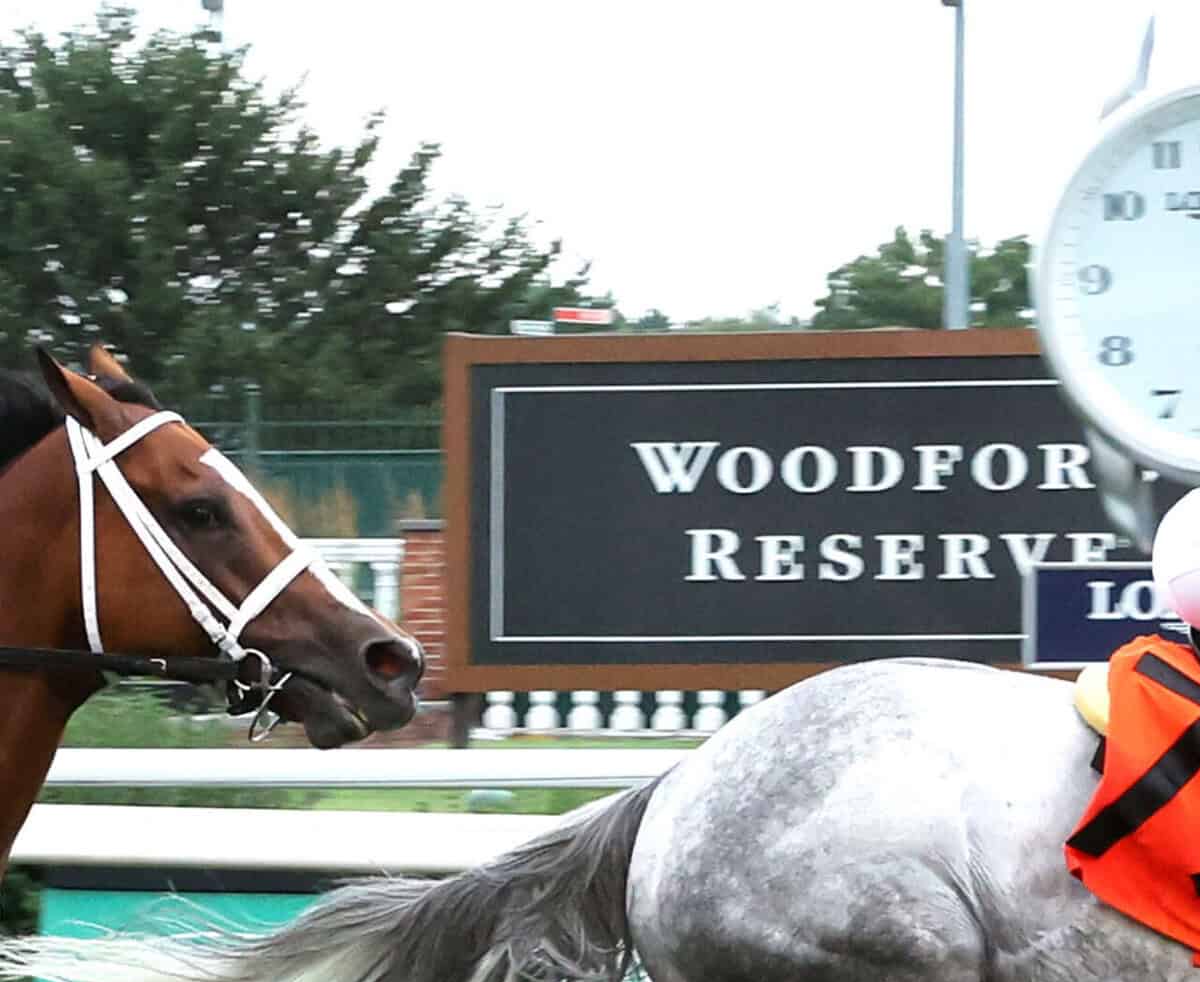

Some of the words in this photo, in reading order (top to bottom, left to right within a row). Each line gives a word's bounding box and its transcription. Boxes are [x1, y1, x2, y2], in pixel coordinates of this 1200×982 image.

[1151, 141, 1182, 169] 11
[1102, 190, 1146, 221] 10
[1078, 264, 1113, 295] 9
[1098, 335, 1134, 367] 8
[1152, 388, 1183, 418] 7
[630, 441, 1160, 494] WOODFOR
[684, 529, 1118, 581] RESERVE
[1086, 580, 1182, 620] LO
